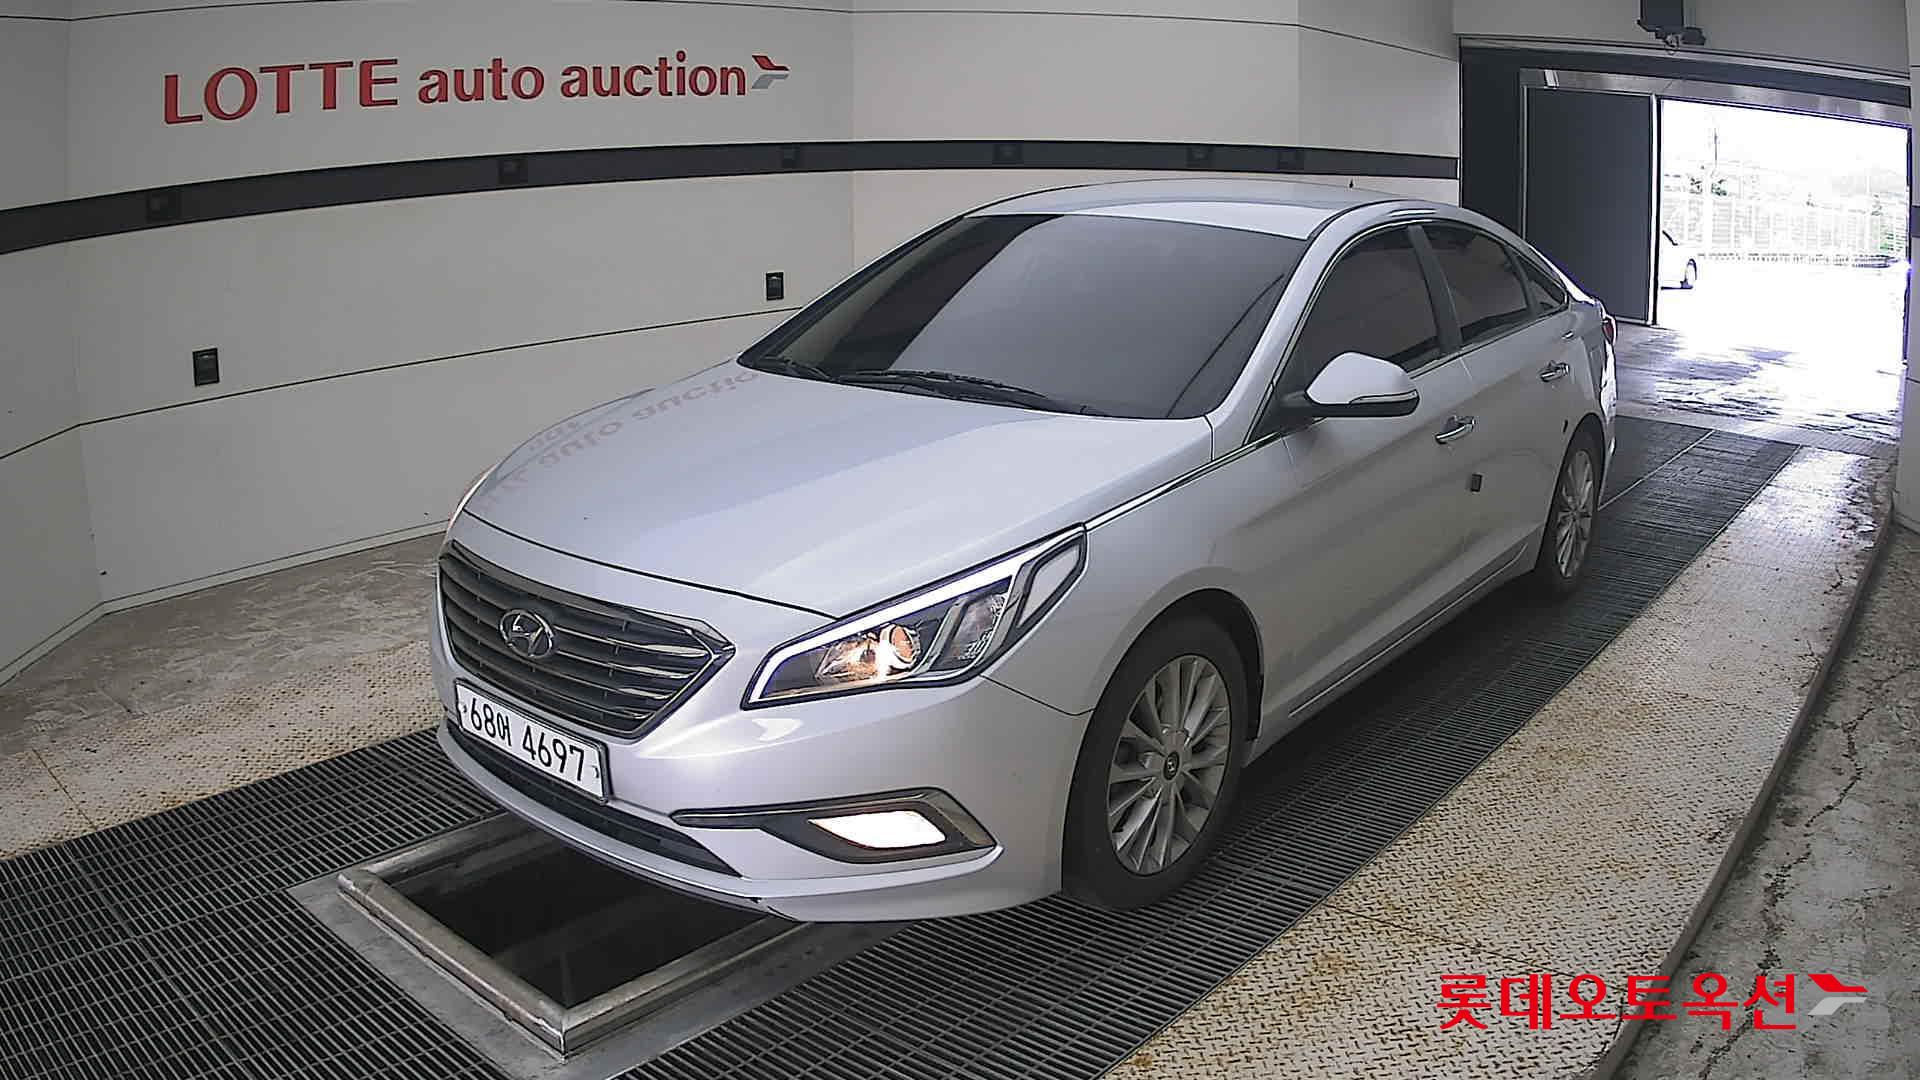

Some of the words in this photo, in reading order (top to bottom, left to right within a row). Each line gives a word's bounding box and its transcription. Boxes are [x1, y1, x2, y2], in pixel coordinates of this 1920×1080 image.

[163, 58, 399, 126] LOTTE
[418, 58, 545, 104] auto
[561, 51, 748, 97] auction
[470, 697, 512, 747] 68어
[522, 724, 585, 781] 4697
